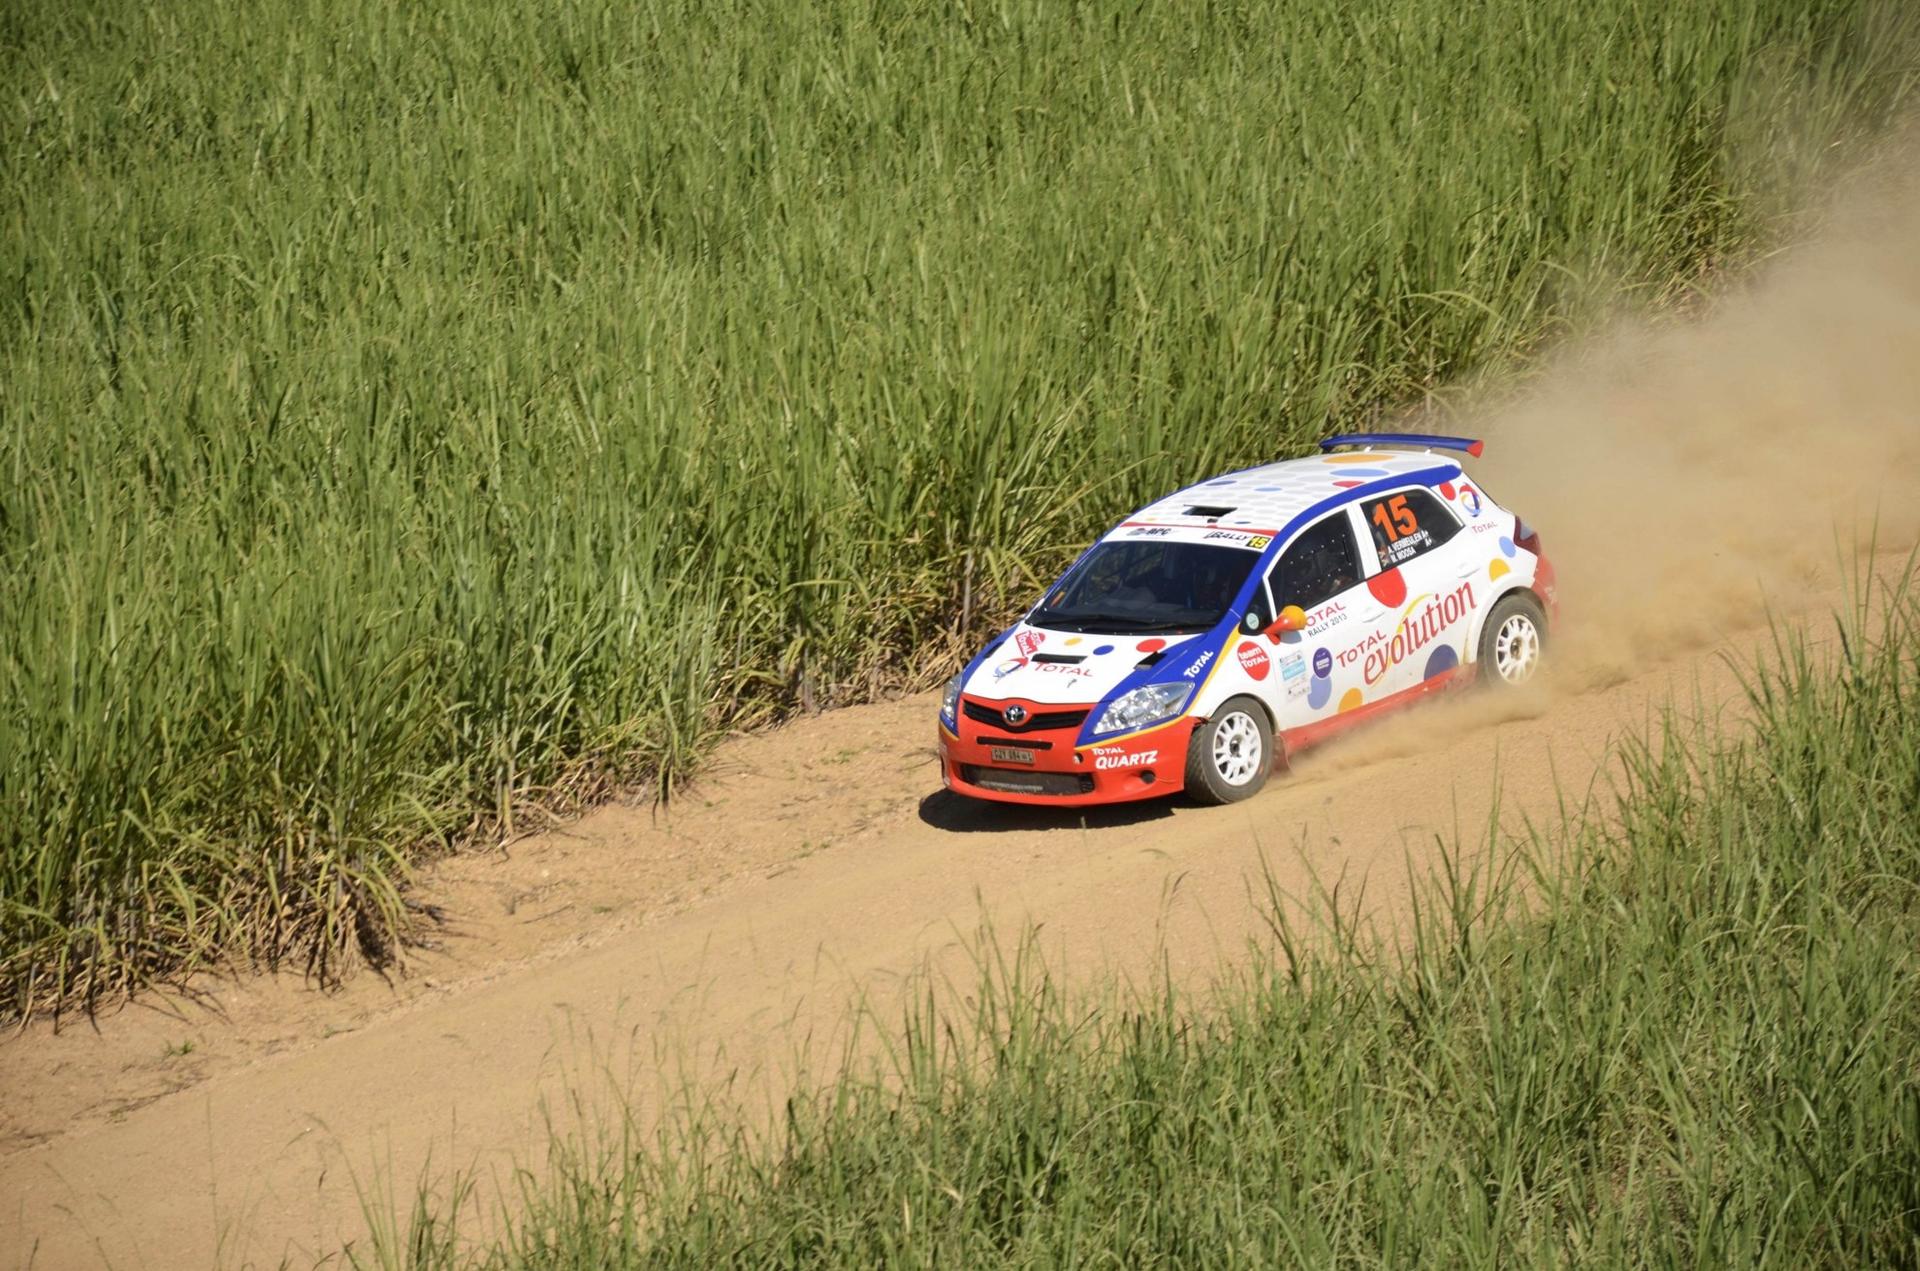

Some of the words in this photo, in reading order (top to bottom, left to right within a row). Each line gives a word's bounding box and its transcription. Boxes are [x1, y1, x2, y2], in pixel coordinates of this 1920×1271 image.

[1373, 494, 1418, 542] 15
[1471, 522, 1497, 534] TOTAL
[1251, 536, 1268, 548] 15
[1304, 602, 1346, 627] OTAL
[1307, 622, 1330, 638] RALLY
[1331, 613, 1348, 626] 2013
[1363, 582, 1478, 685] evolution
[1336, 629, 1387, 668] TOTAL
[1035, 661, 1094, 677] TOTAL
[1184, 650, 1214, 679] TOTAL
[1240, 655, 1270, 669] TOTAL
[1092, 747, 1125, 756] TOTAL
[1095, 750, 1158, 769] QUARTZ
